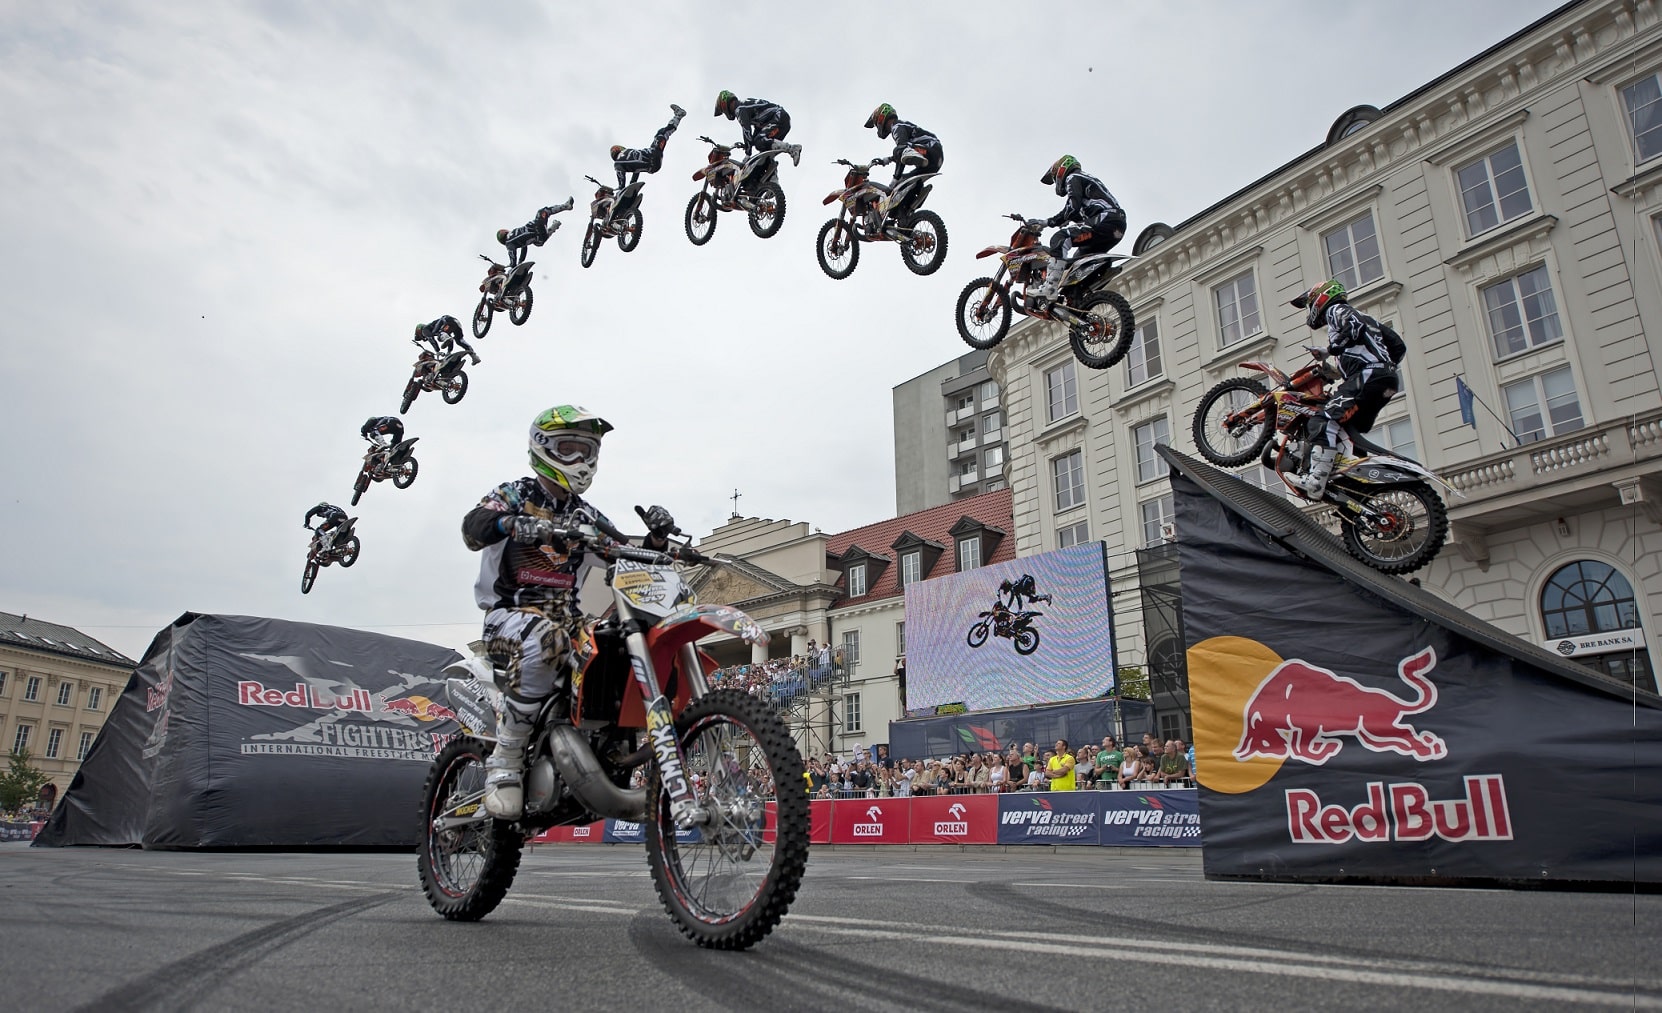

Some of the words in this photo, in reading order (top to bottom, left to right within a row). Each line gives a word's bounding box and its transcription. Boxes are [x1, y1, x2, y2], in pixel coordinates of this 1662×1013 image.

[1597, 638, 1621, 647] BANK
[1621, 636, 1633, 644] SA
[238, 680, 308, 708] Red
[320, 722, 432, 752] FIGHTERS
[244, 744, 349, 757] INTERNATIONAL
[355, 748, 416, 759] FREESTYLE
[651, 724, 688, 800] CMYK
[1285, 781, 1390, 844] Red
[1388, 773, 1514, 843] Bull
[1002, 810, 1052, 825] verva
[1051, 812, 1096, 825] street
[1104, 809, 1164, 825] verva
[855, 825, 881, 834] ORLEN
[936, 824, 966, 833] ORLEN
[1026, 824, 1069, 836] racing
[1134, 824, 1184, 838] racing
